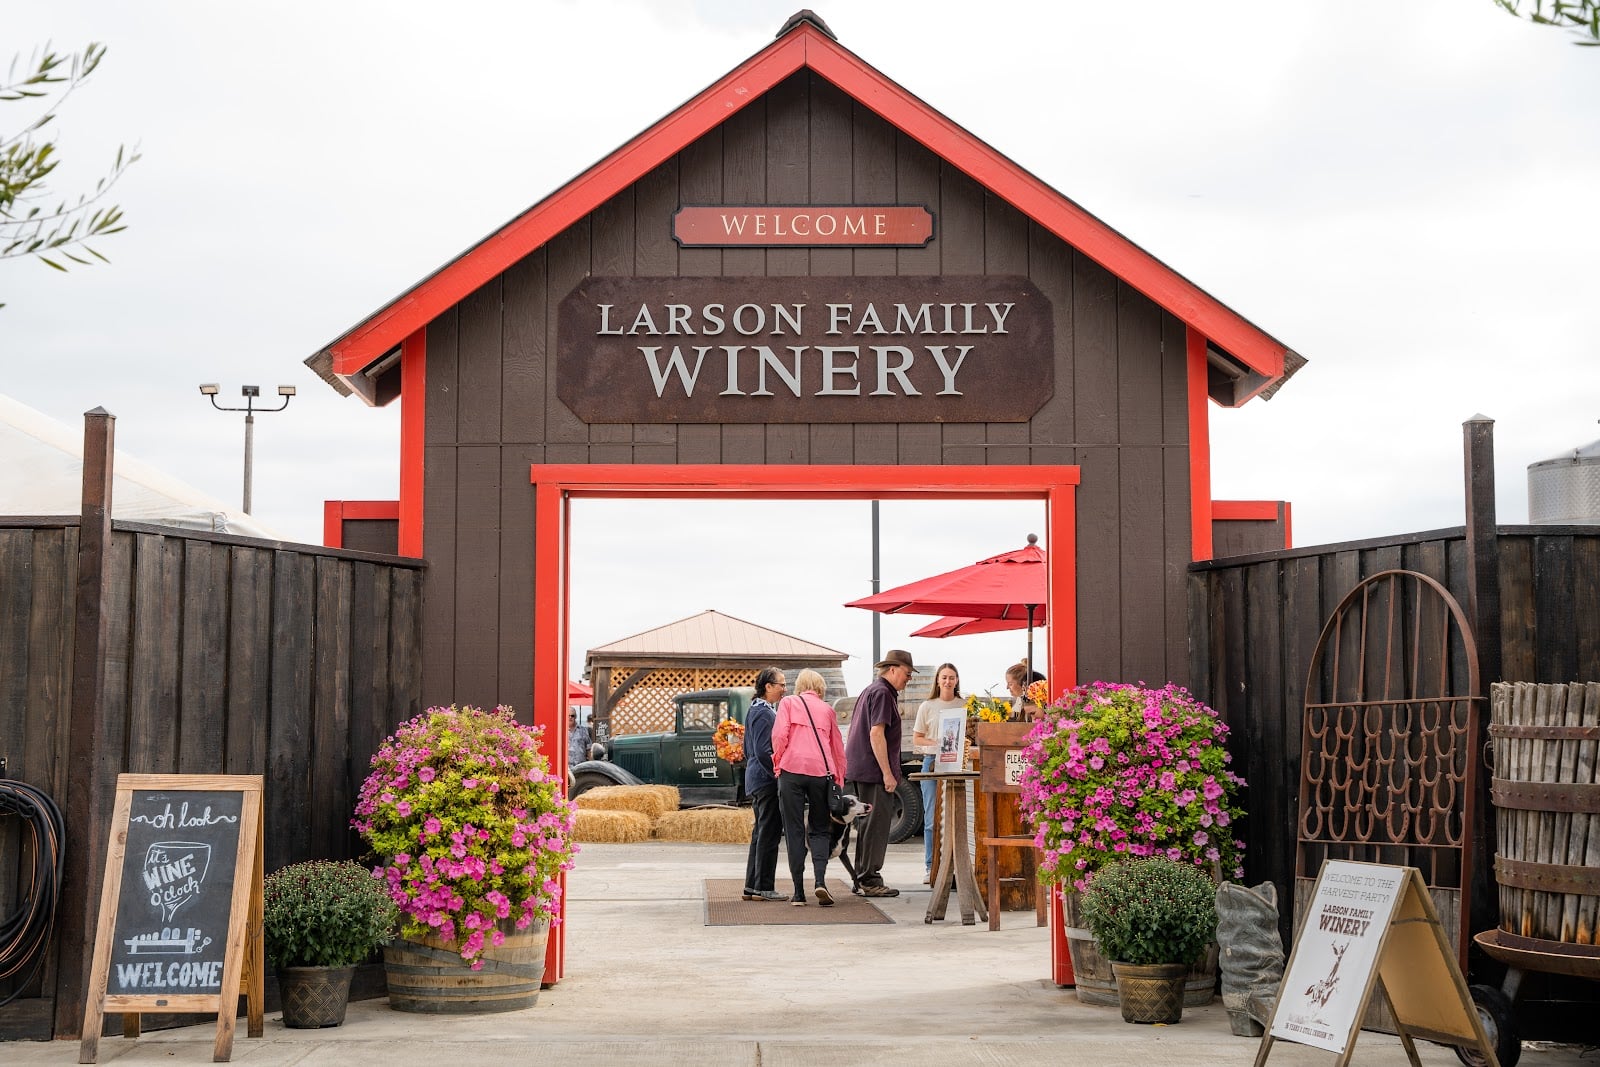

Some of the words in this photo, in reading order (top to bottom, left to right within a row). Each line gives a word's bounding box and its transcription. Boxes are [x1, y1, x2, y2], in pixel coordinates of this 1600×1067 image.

[720, 213, 888, 236] WELCOME
[596, 303, 805, 336] LARSON
[825, 302, 1016, 335] FAMILY
[636, 345, 976, 398] WINERY
[148, 802, 175, 829] oh
[178, 801, 214, 827] look
[143, 853, 197, 890] WINE
[1324, 873, 1363, 885] WELCOME
[1364, 877, 1376, 887] TO
[1377, 878, 1396, 889] THE
[1320, 886, 1360, 899] HARVEST
[1322, 904, 1349, 916] LARSON
[1349, 908, 1375, 919] FAMILY
[1319, 913, 1371, 937] WINERY
[116, 962, 223, 988] WELCOME
